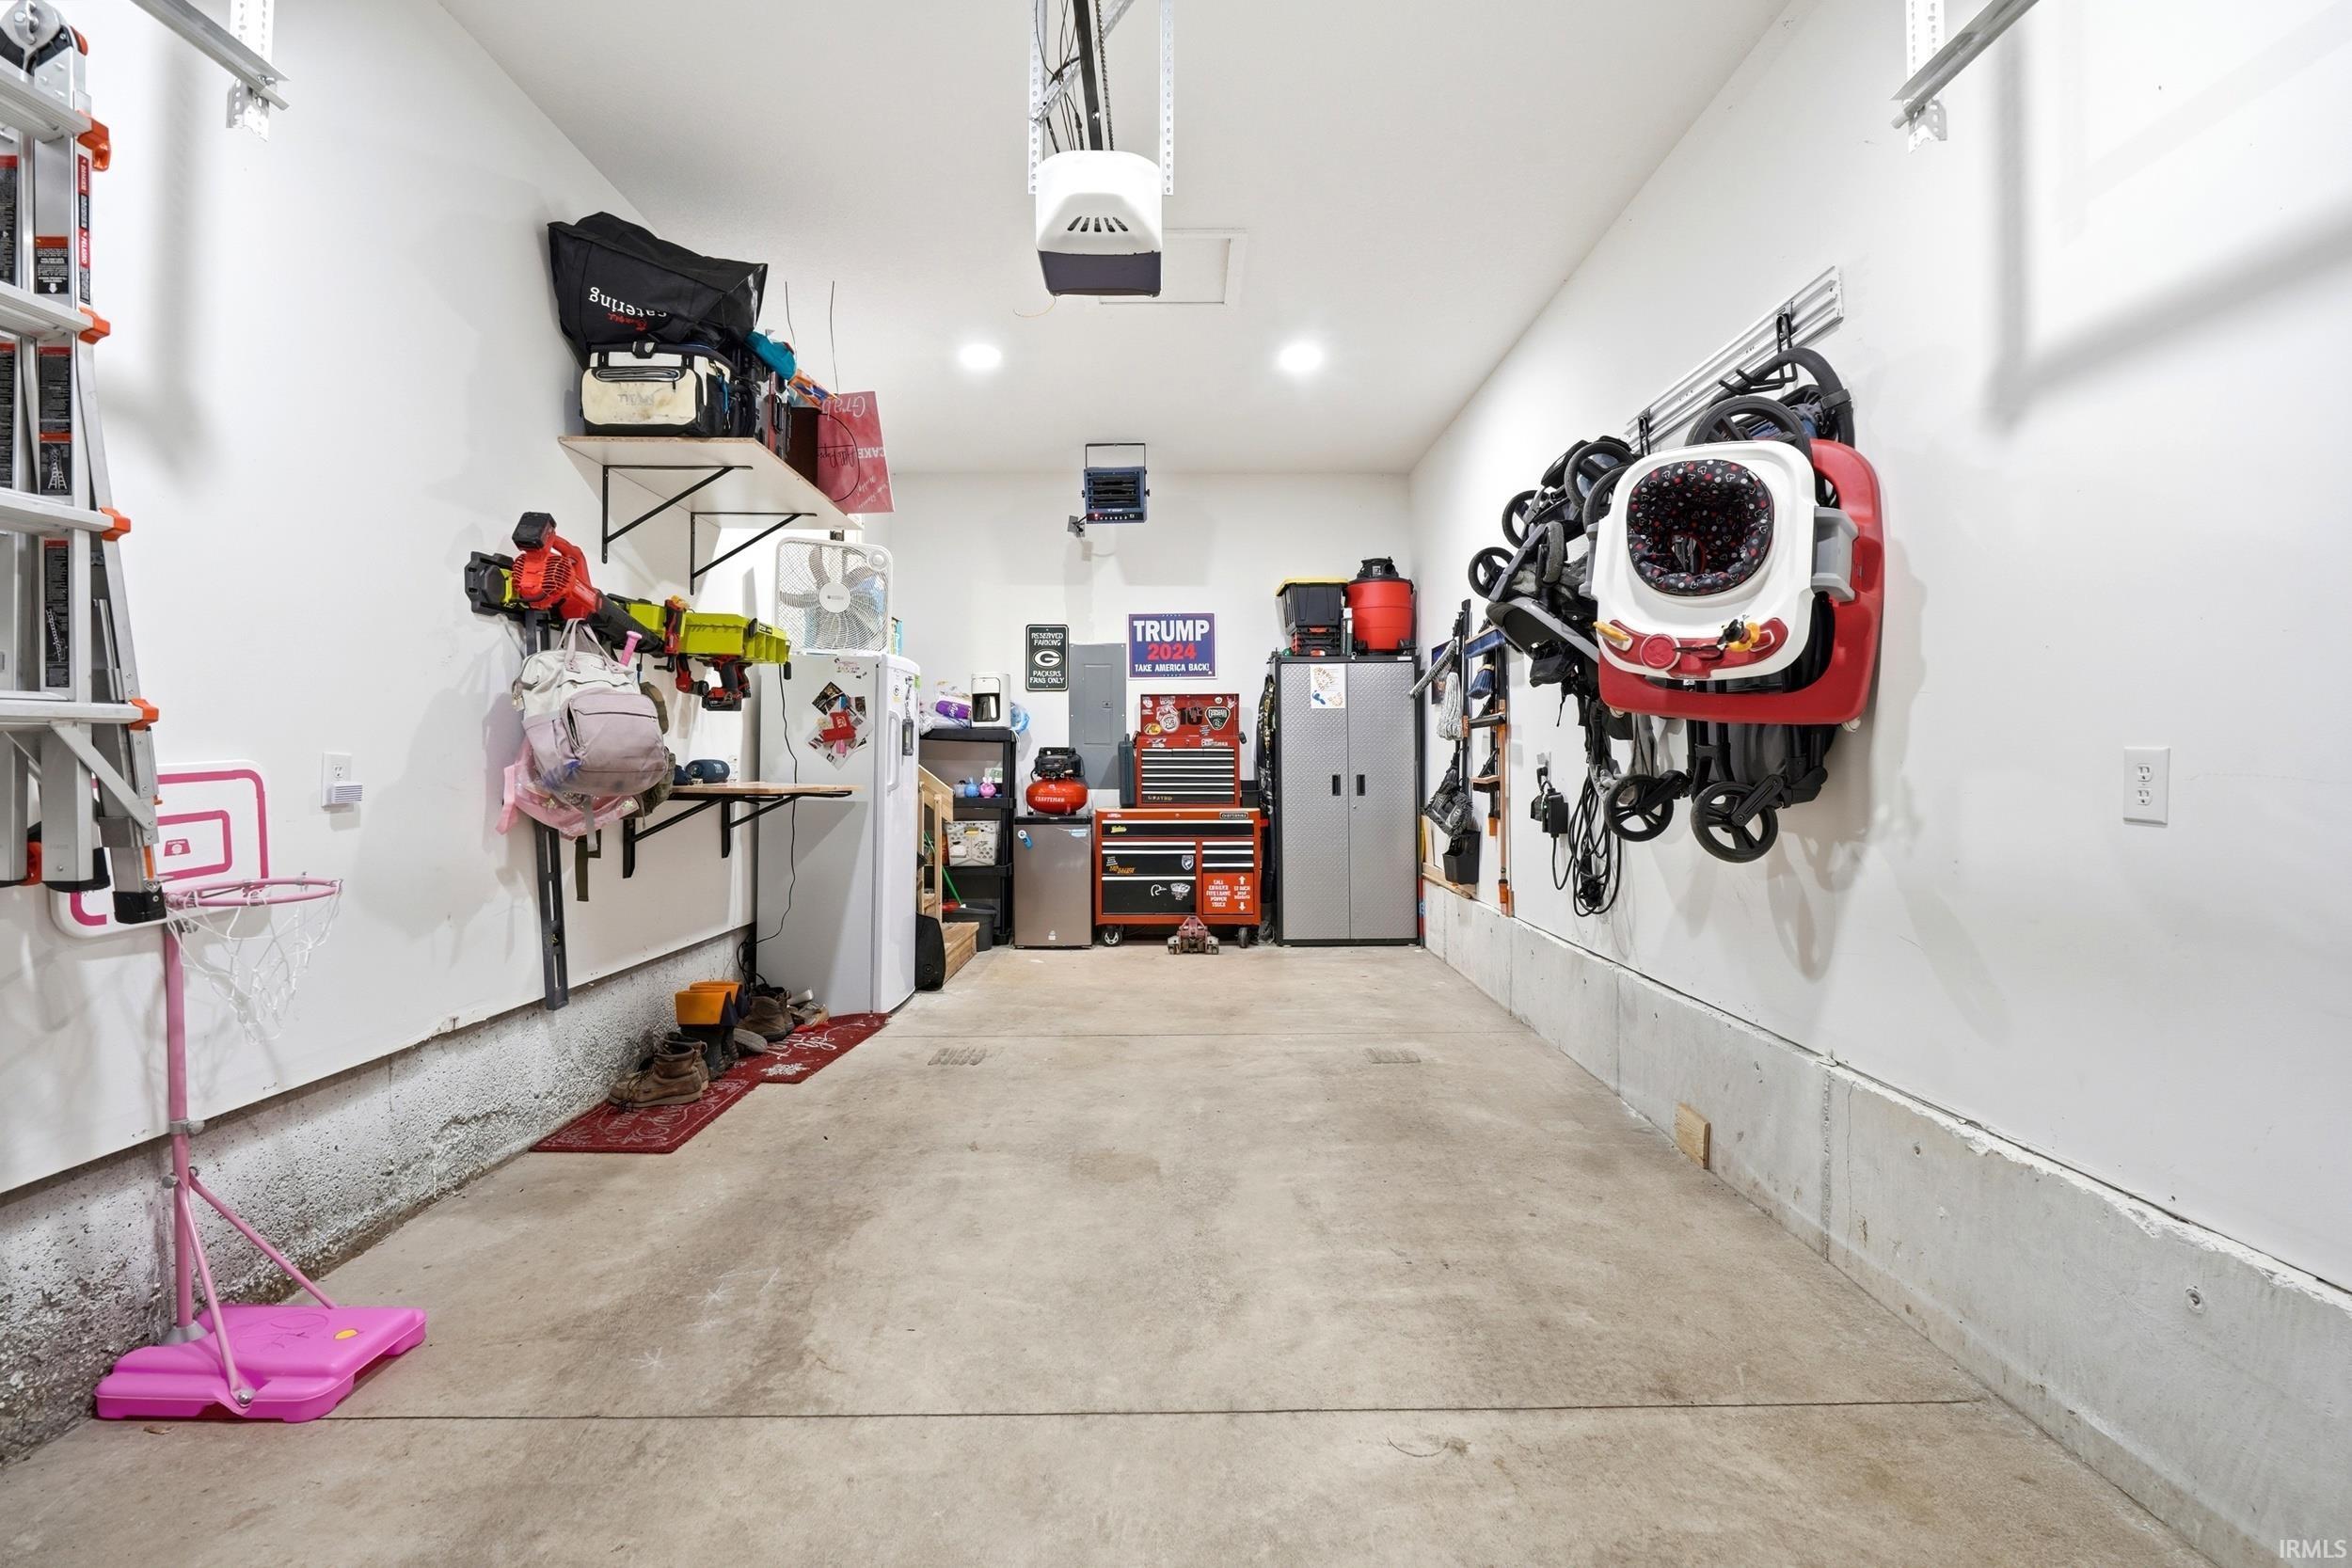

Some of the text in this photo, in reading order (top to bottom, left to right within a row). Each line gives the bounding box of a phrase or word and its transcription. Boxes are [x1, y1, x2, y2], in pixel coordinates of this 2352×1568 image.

[821, 395, 866, 421] Grab
[1133, 620, 1210, 642] TRUMP
[1034, 650, 1060, 667] G
[1147, 644, 1197, 660] 2024
[1135, 662, 1210, 673] TAKE AMERICA BACK!
